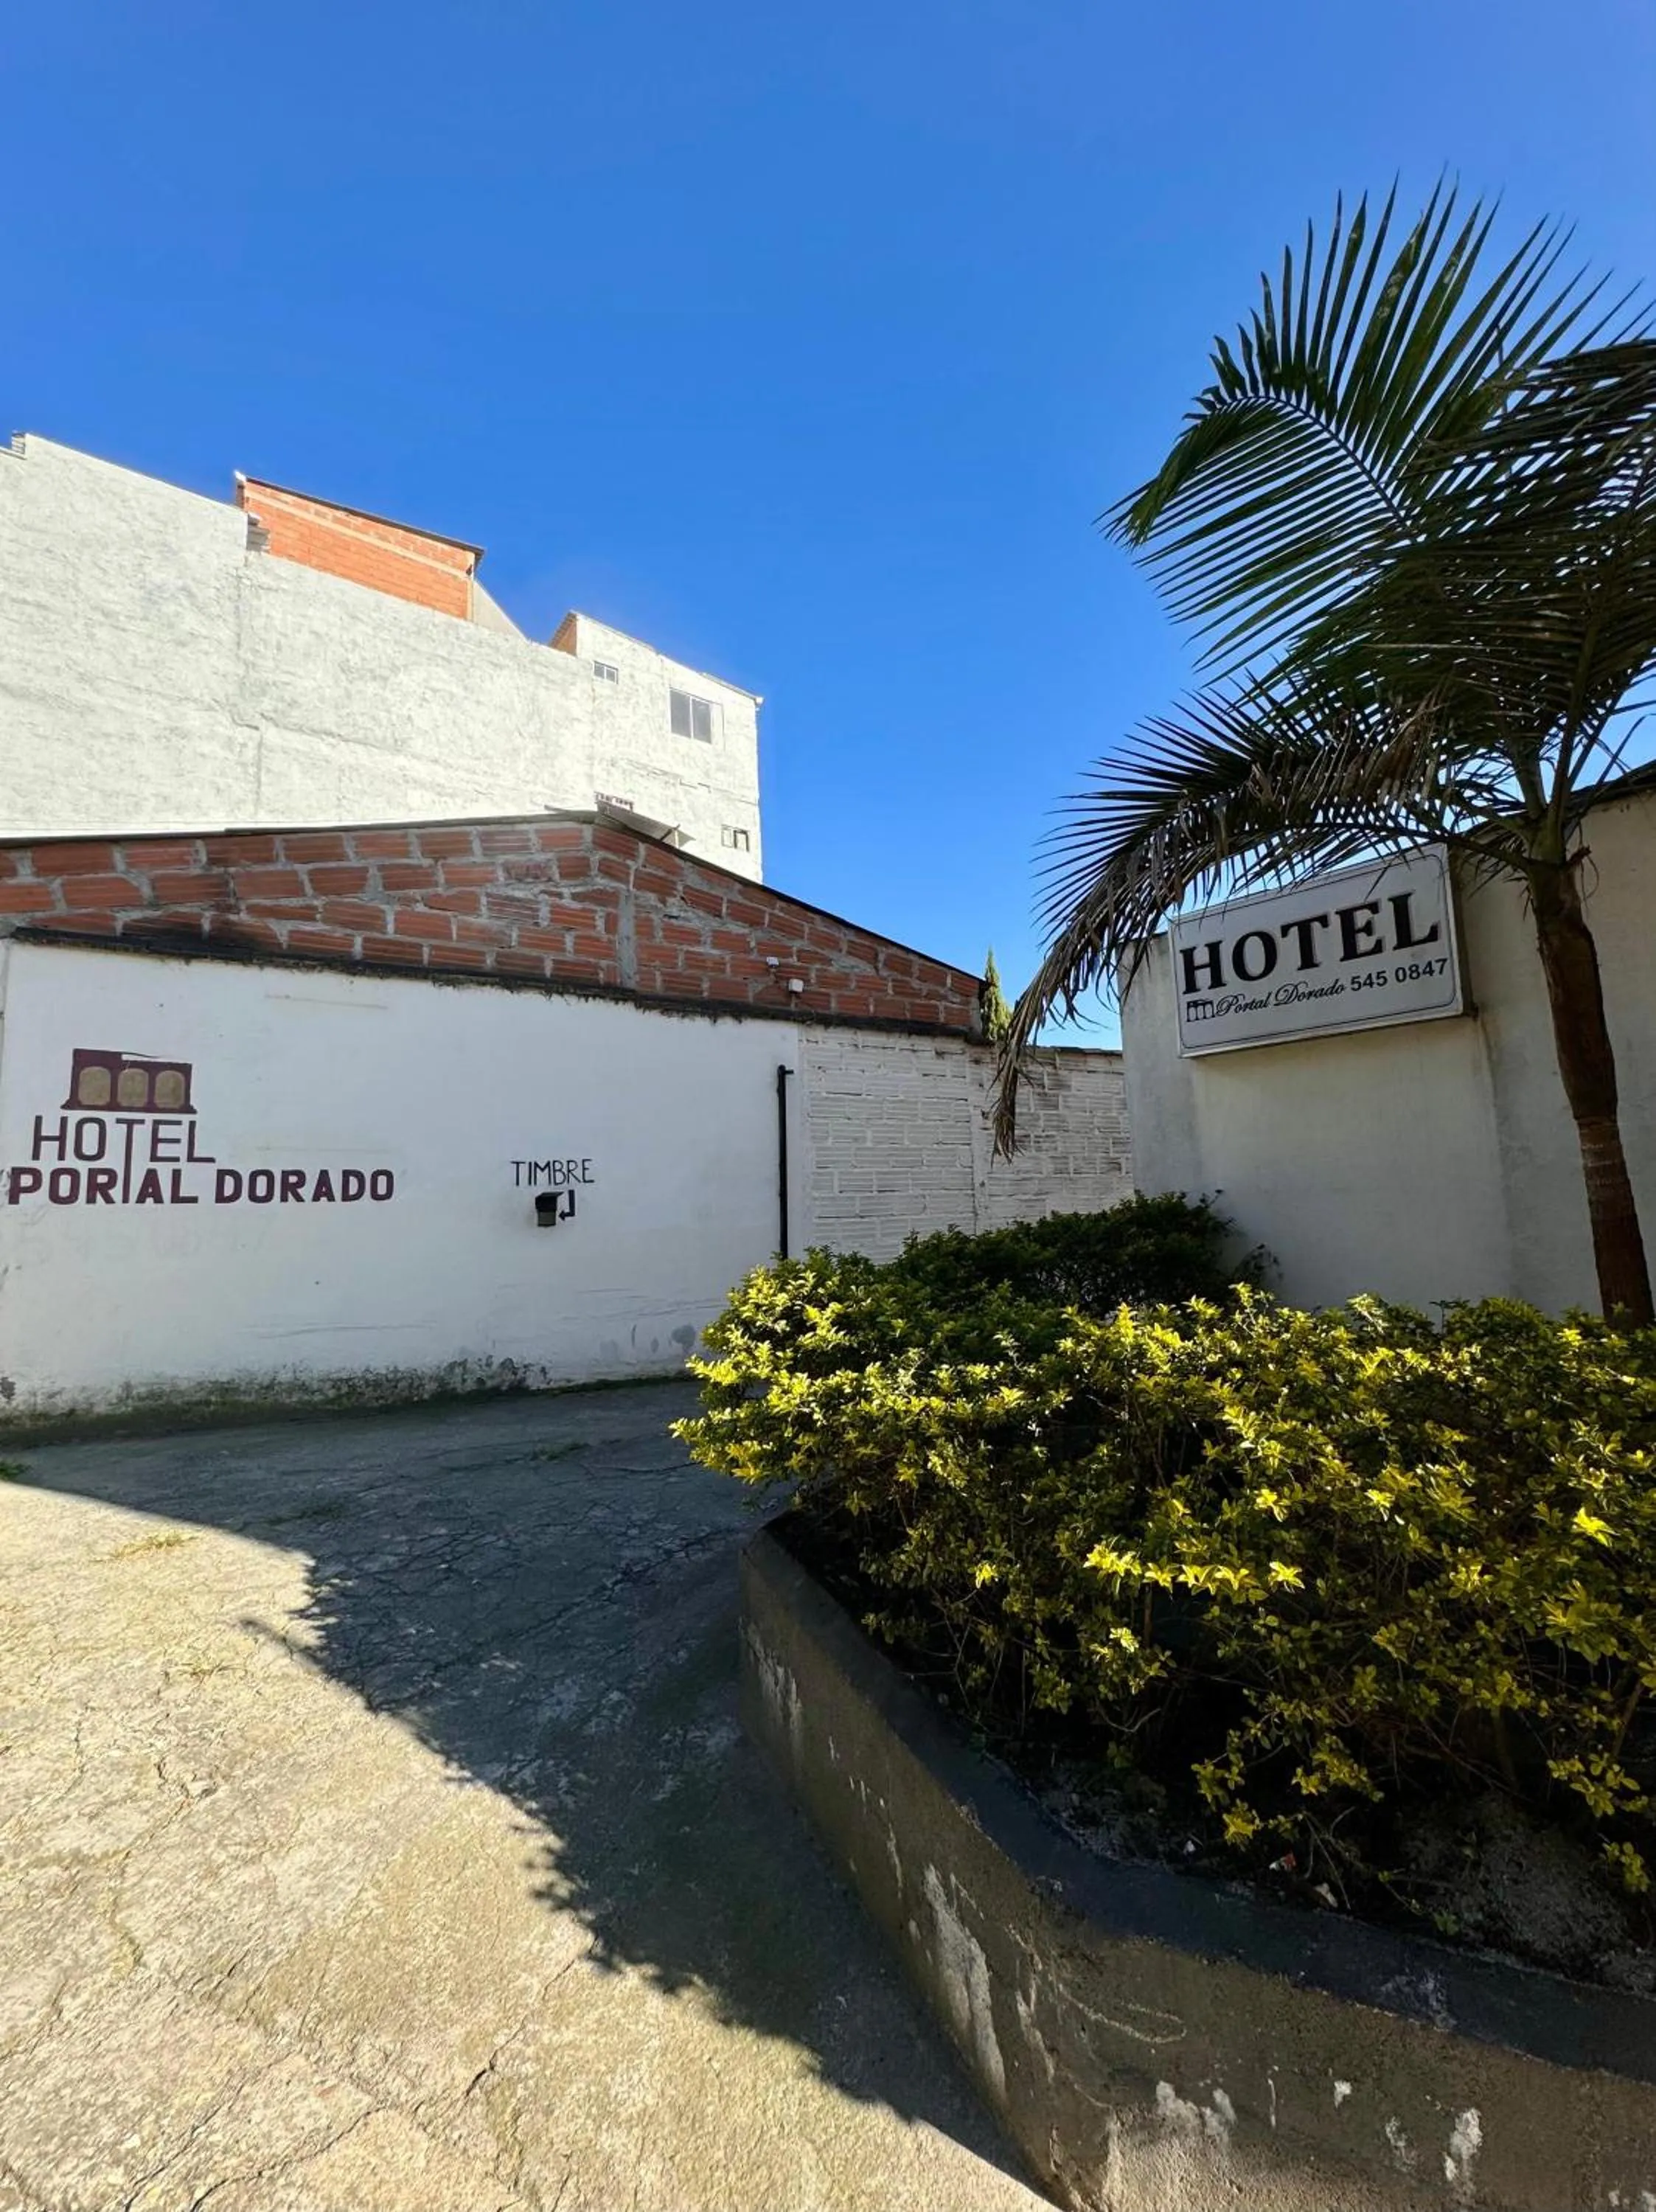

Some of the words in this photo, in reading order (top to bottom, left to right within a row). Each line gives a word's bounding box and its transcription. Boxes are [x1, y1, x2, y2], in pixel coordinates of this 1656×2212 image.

[1180, 891, 1439, 995] HOTEL
[1215, 992, 1273, 1018] Portal
[1273, 979, 1346, 1006] Dorado
[1350, 967, 1388, 992] 545
[1394, 958, 1449, 983] 0847
[31, 1115, 216, 1164] HOTEL
[7, 1166, 199, 1206] PORTAL
[214, 1168, 395, 1205] DORADO
[509, 1158, 595, 1186] TIMBRE
